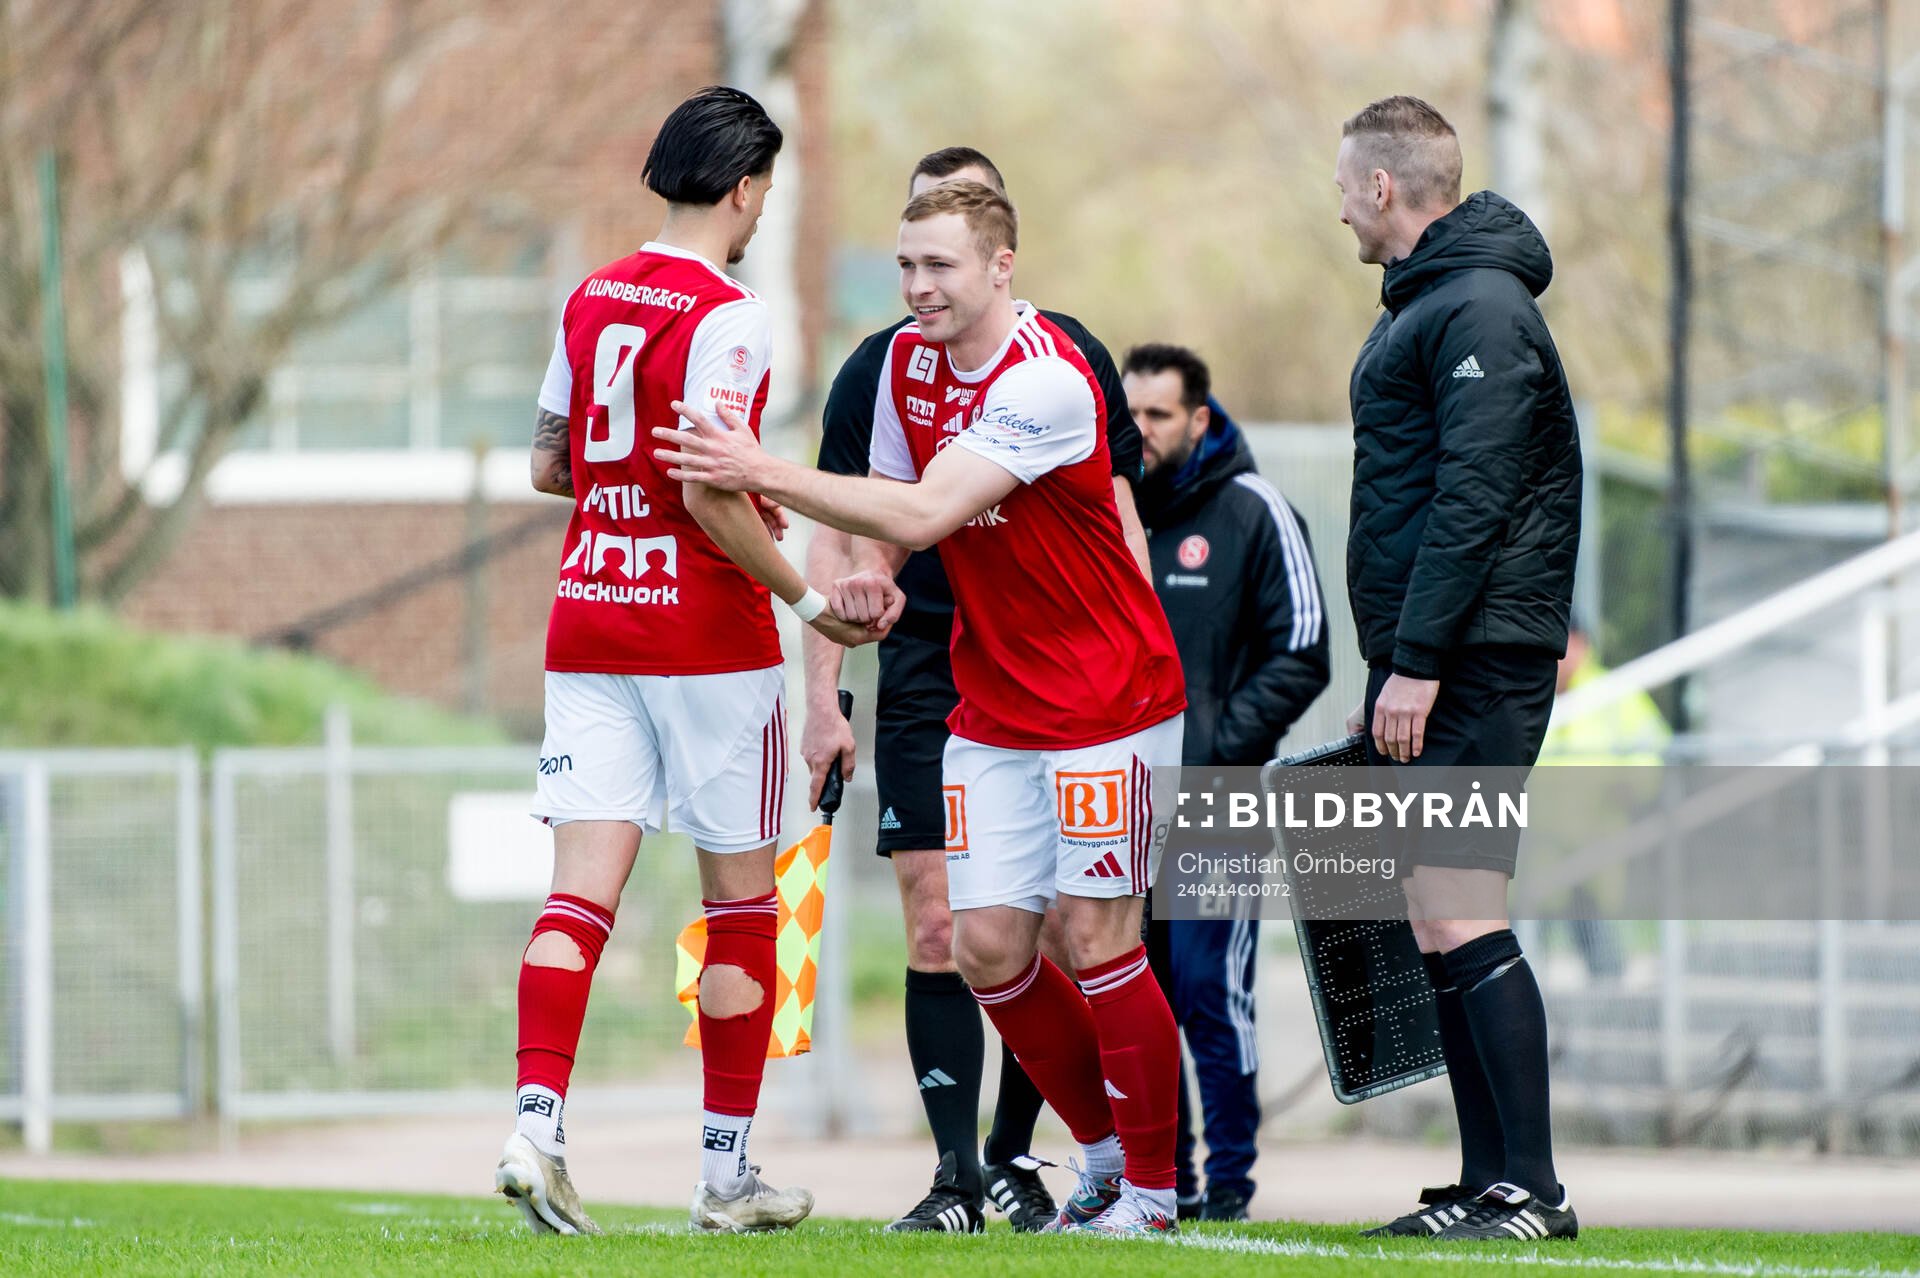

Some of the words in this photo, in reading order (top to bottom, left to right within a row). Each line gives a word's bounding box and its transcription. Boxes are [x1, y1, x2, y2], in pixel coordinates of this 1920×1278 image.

[1452, 369, 1485, 378] adidas
[584, 323, 647, 463] 9
[557, 577, 679, 605] clockwork
[1065, 781, 1118, 828] BJ
[520, 1095, 552, 1115] FS
[703, 1126, 734, 1151] FS
